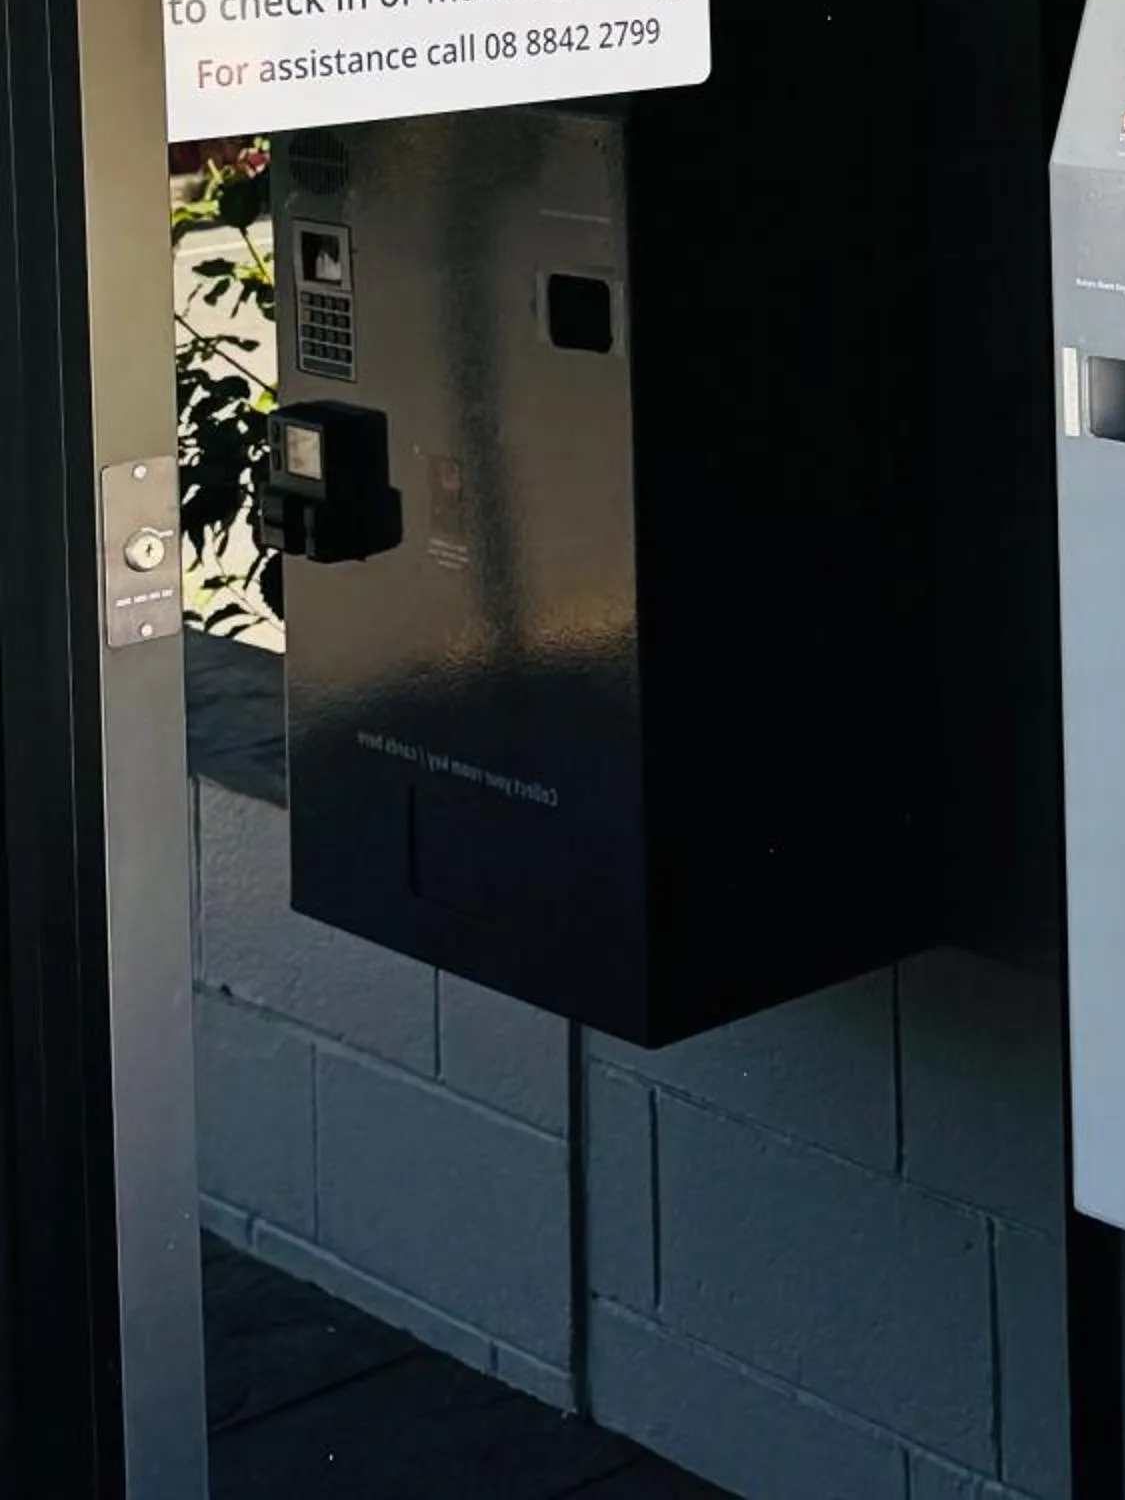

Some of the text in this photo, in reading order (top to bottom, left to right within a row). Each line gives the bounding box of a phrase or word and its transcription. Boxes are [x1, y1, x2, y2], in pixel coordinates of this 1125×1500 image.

[198, 18, 660, 88] For assistance call 08 8842 2799
